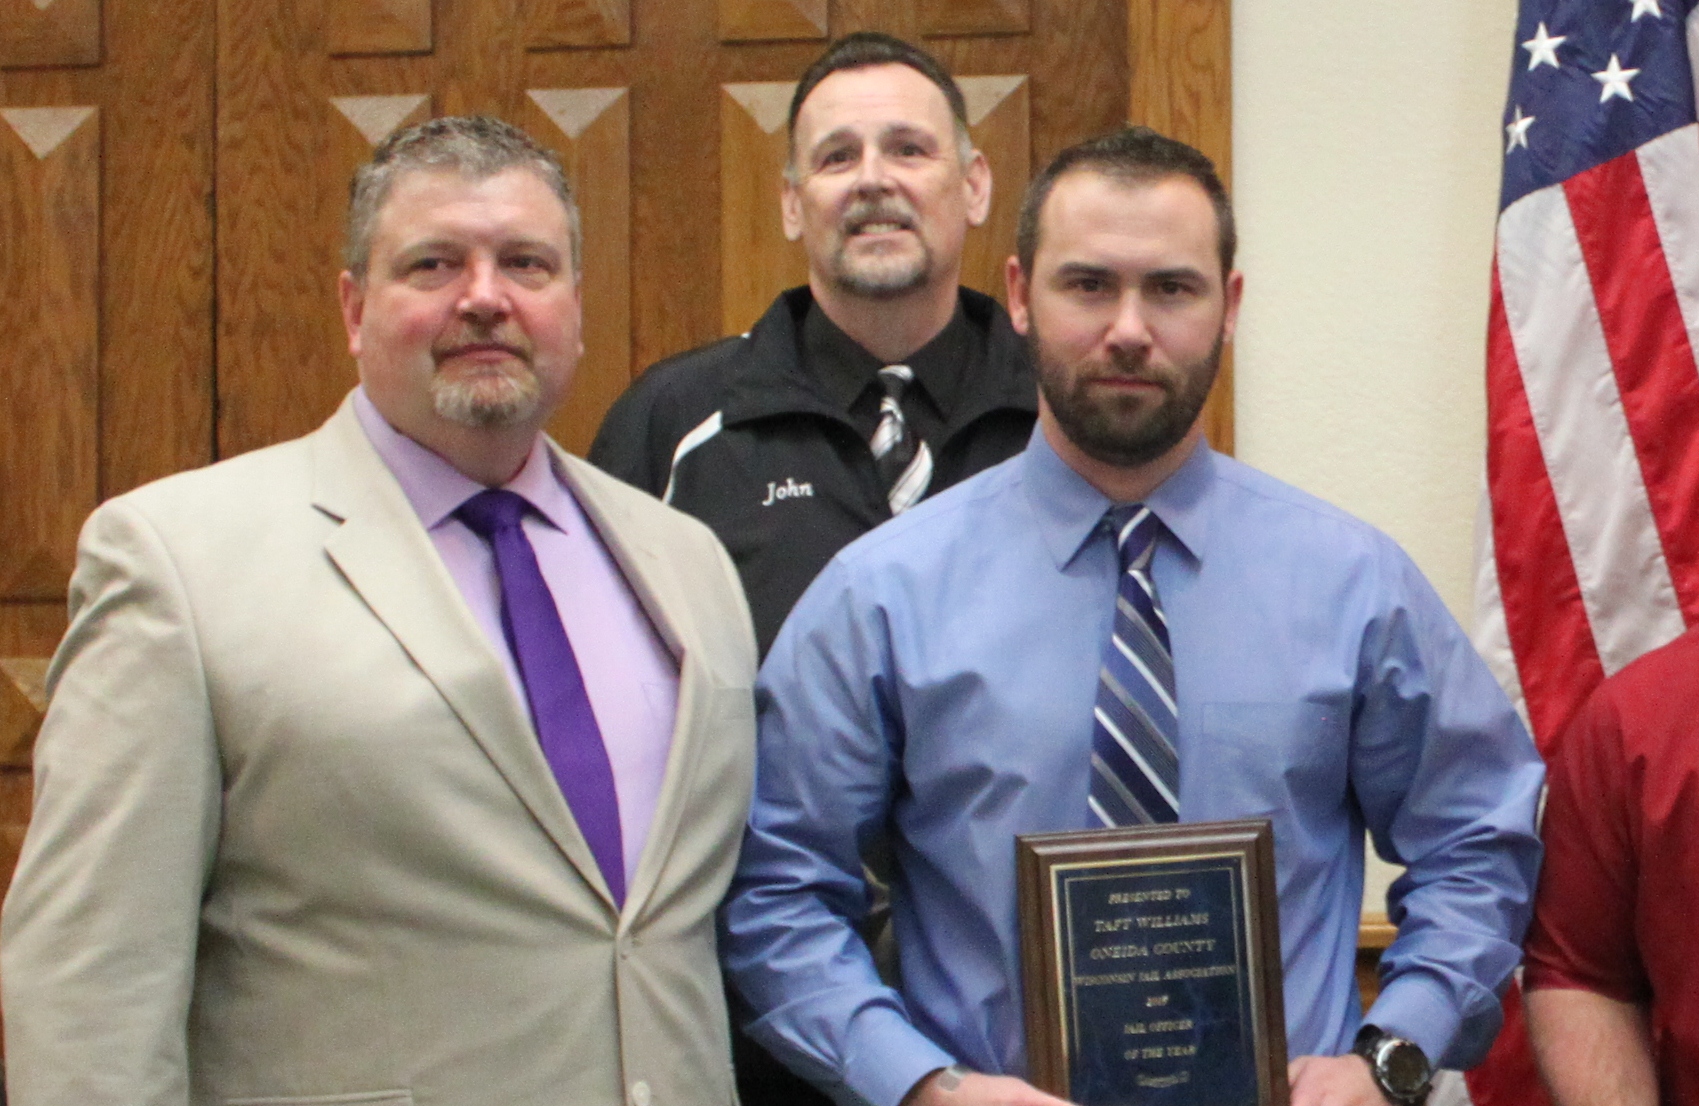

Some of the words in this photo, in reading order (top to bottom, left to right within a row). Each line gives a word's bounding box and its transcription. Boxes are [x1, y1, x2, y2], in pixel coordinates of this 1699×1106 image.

[762, 477, 814, 506] John
[1175, 889, 1190, 900] TO
[1094, 918, 1132, 932] TAFT
[1136, 912, 1209, 928] WILLIAMS
[1090, 943, 1148, 960] ONEIDA
[1153, 939, 1216, 955] COUNTY
